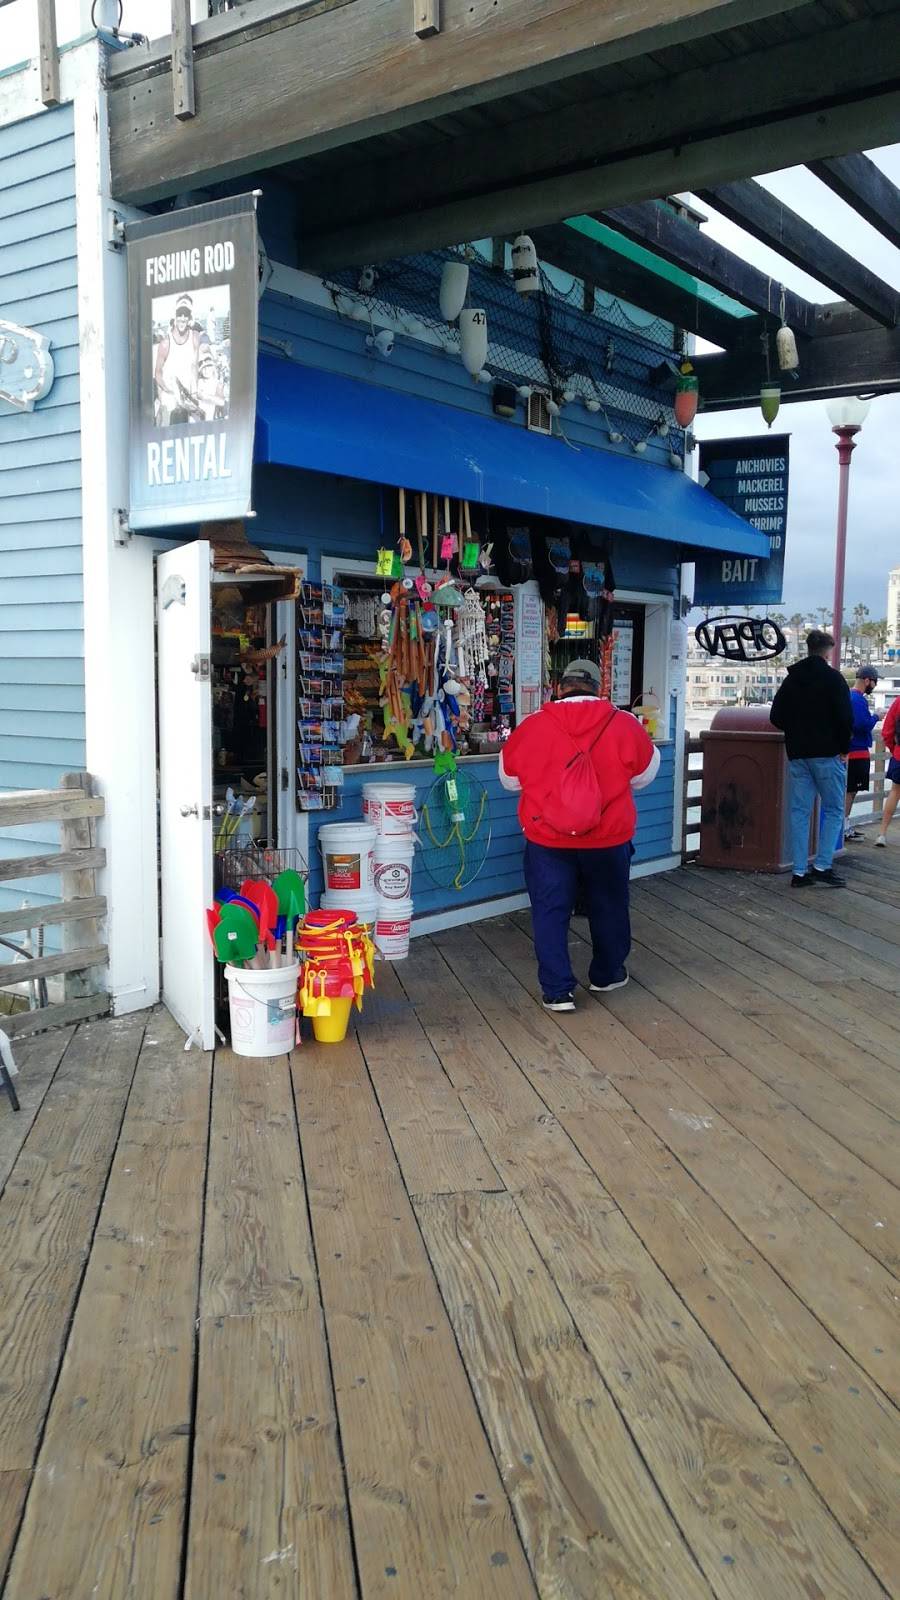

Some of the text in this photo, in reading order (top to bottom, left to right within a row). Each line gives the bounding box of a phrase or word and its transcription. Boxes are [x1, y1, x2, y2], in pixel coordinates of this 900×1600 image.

[145, 241, 235, 286] FISHING ROD
[147, 432, 233, 487] RENTAL
[735, 457, 786, 475] ANCHOVIES
[738, 478, 785, 494] MACKEREL
[744, 497, 784, 512] MUSSELS
[721, 558, 759, 583] BAIT
